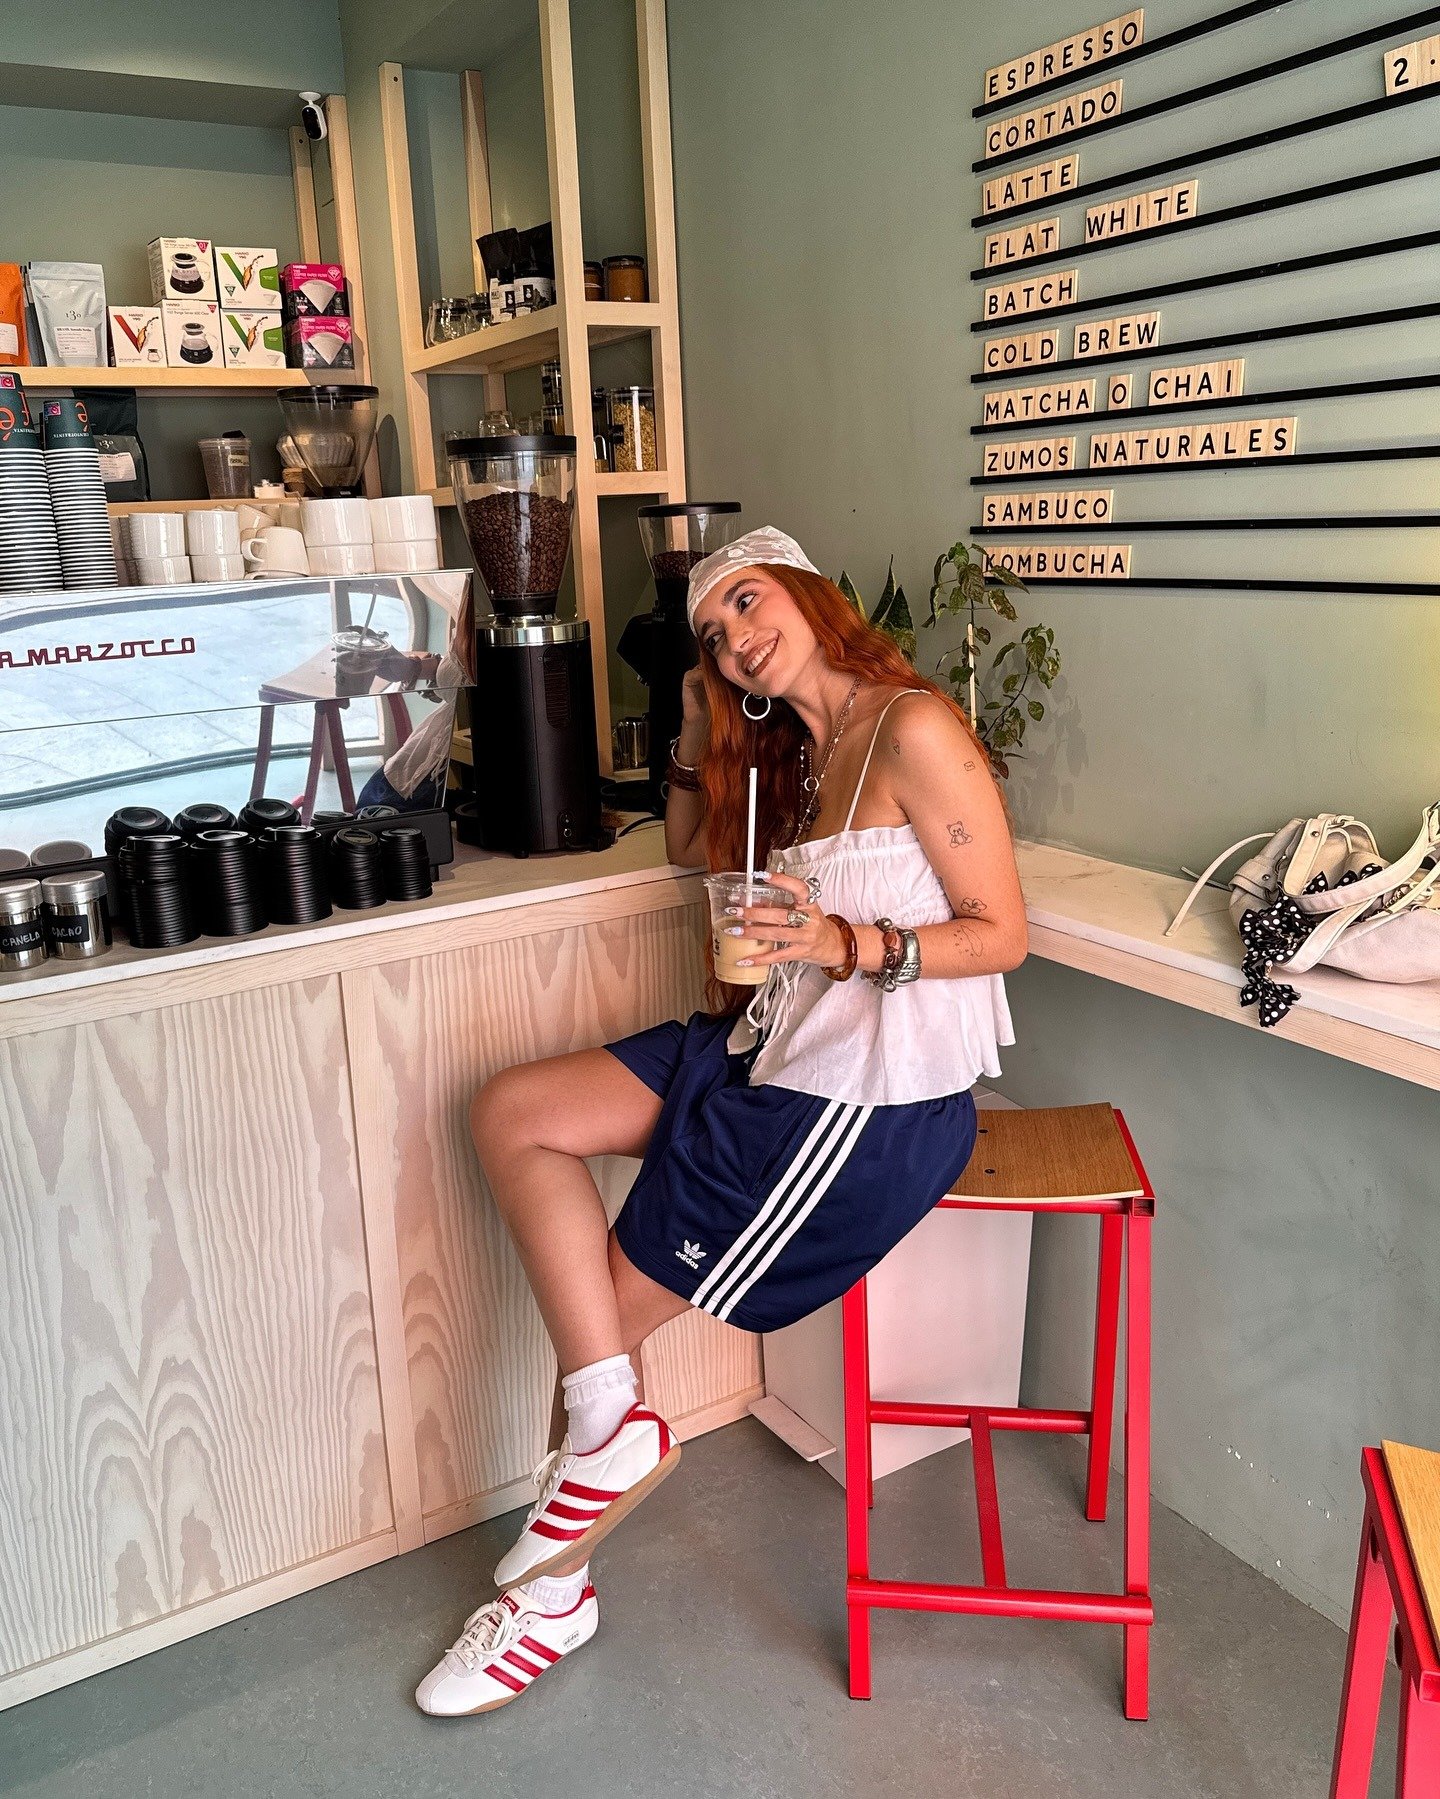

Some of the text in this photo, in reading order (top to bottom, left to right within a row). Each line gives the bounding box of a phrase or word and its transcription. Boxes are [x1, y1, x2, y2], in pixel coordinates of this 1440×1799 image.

[989, 22, 1138, 97] ESPRESSO
[989, 90, 1117, 152] CORTADO
[986, 163, 1072, 210] LATTE
[989, 189, 1190, 263] FLAT WHITE
[988, 277, 1073, 316] BATCH
[987, 320, 1157, 368] COLD BREW
[985, 369, 1232, 421] MATCHA O CHAI
[987, 427, 1288, 472] ZUMOS NATURALES
[987, 497, 1108, 522] SAMBUCO
[985, 551, 1125, 574] KOMBUCHA
[0, 637, 196, 669] A MARZOCCO
[2, 931, 40, 947] CANELA
[52, 925, 83, 938] CACAO
[675, 1250, 699, 1270] adidas
